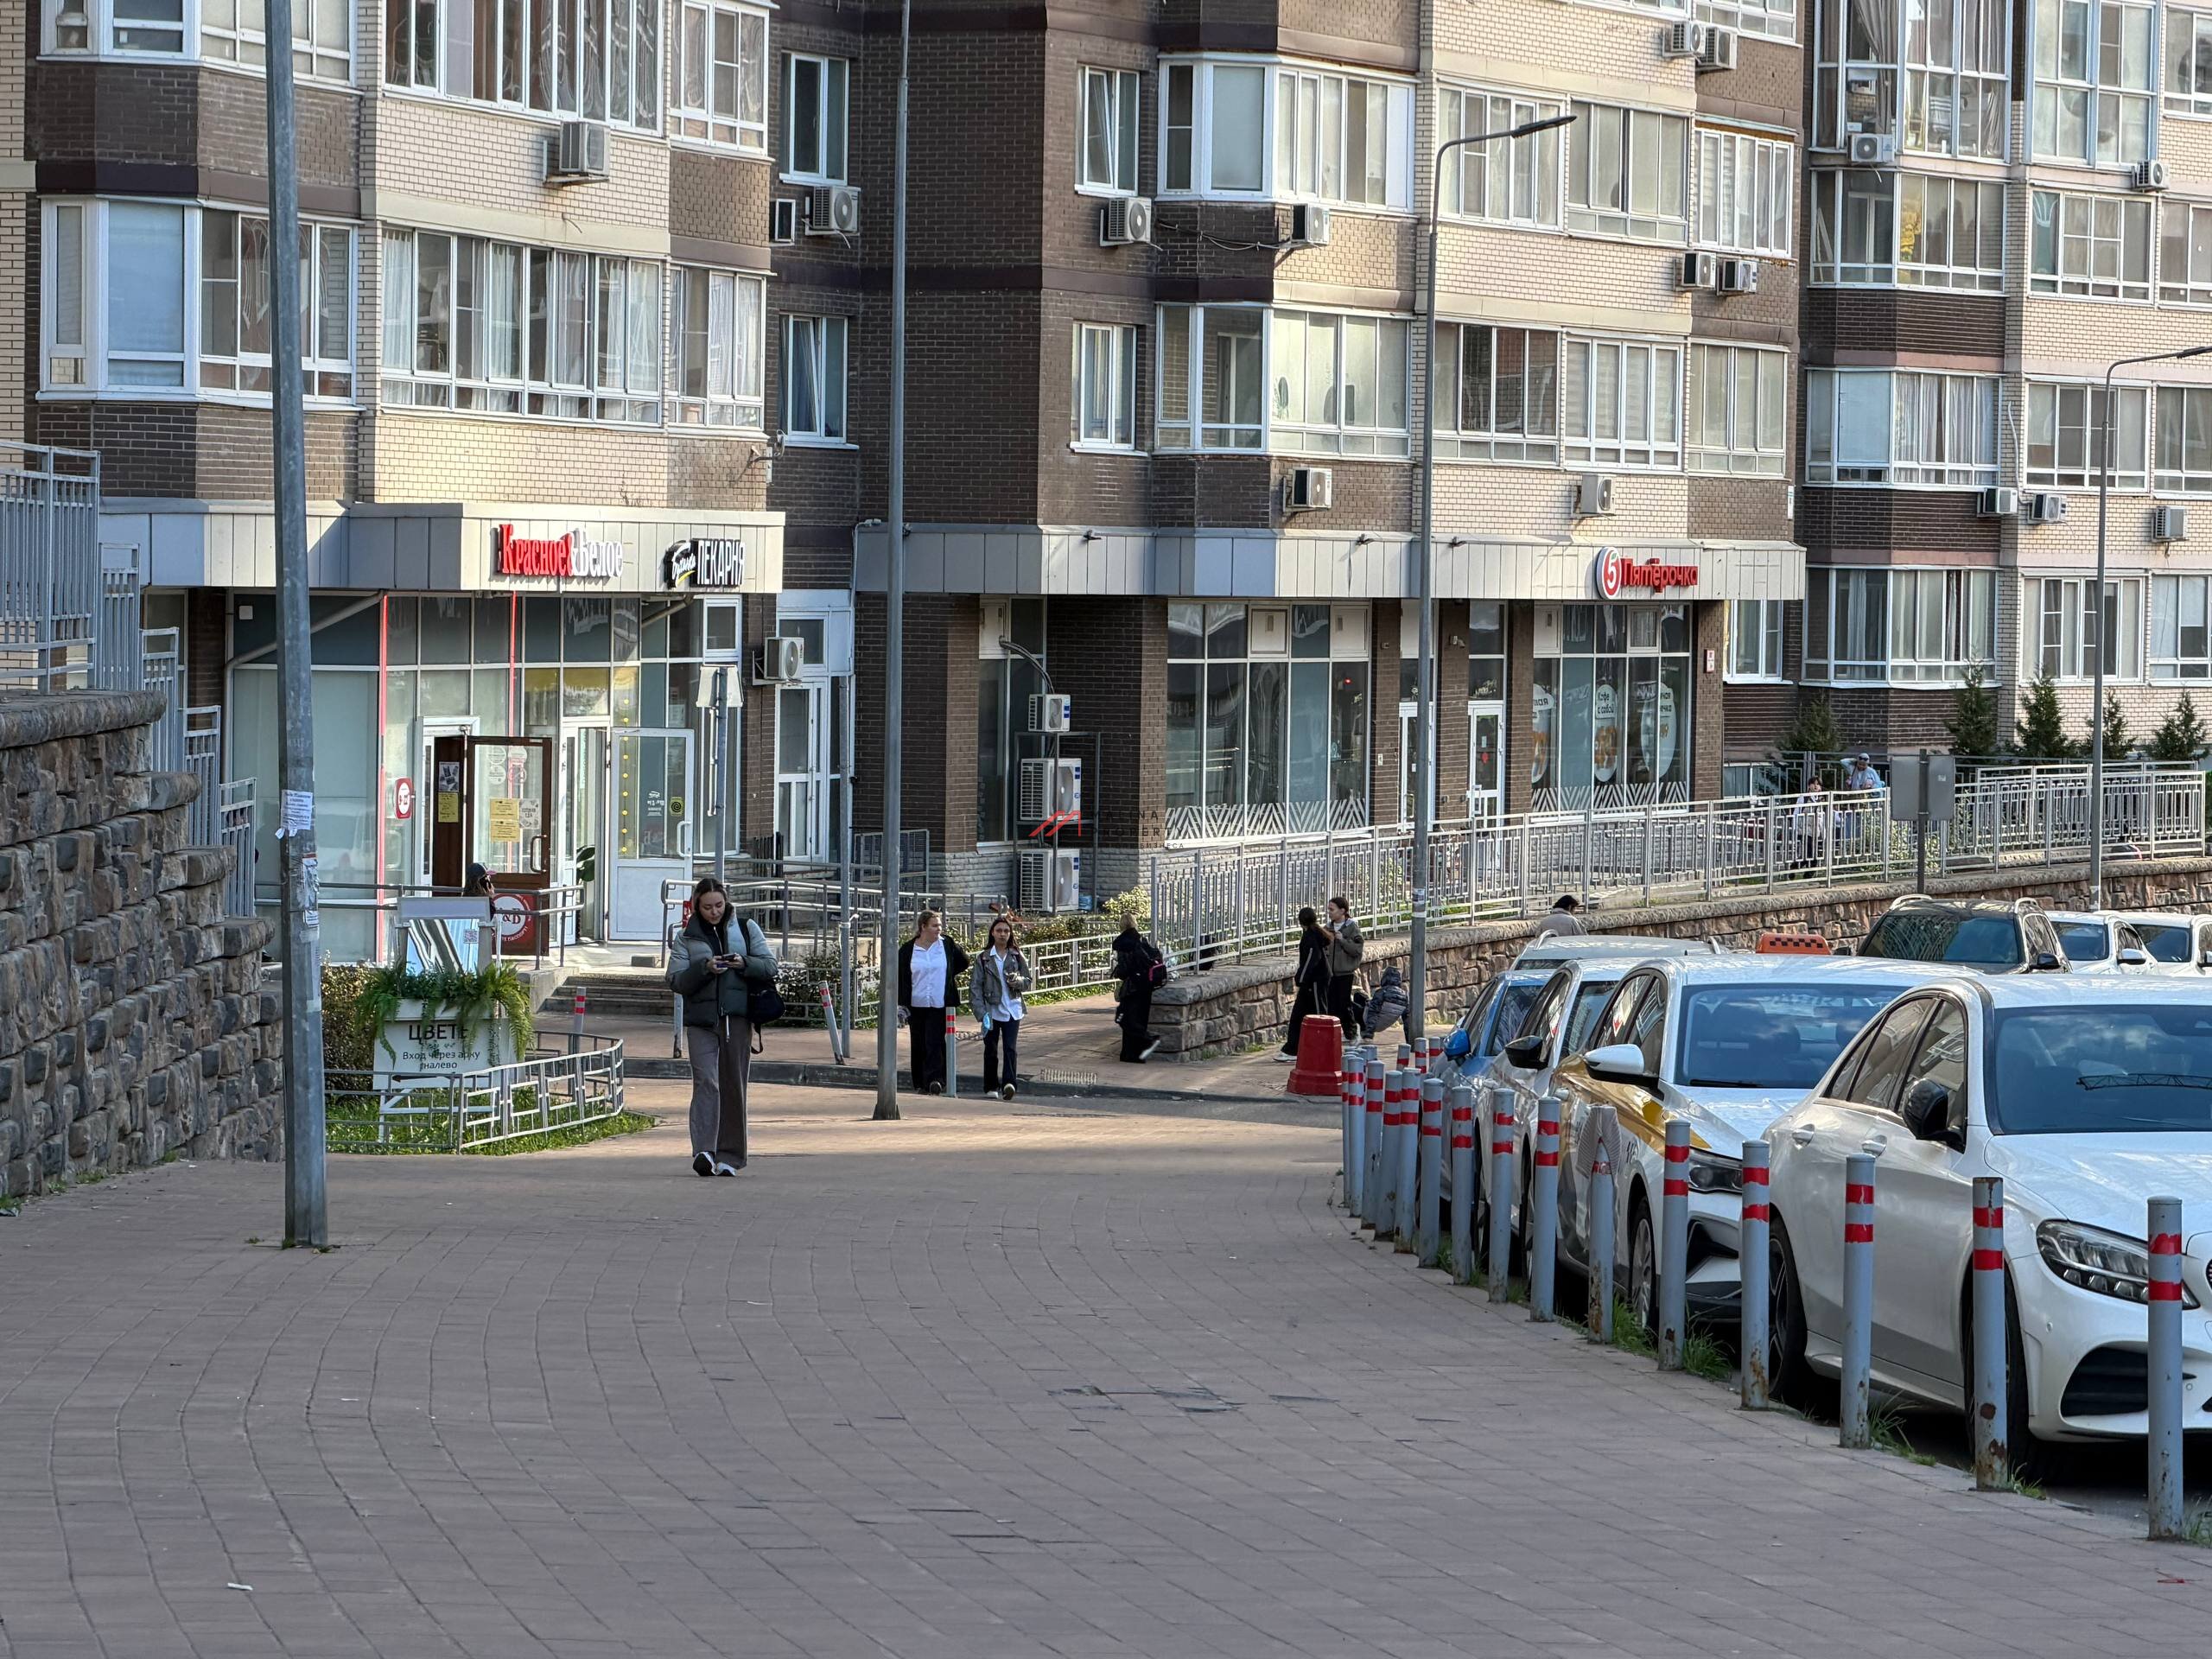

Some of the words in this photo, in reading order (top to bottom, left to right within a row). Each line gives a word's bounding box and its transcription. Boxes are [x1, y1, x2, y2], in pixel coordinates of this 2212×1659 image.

[697, 540, 746, 586] ПЕКАРНЯ
[1622, 558, 1698, 593] Пятёрочка
[403, 1052, 426, 1060] Вход
[429, 1052, 454, 1061] через
[458, 1052, 480, 1061] арку
